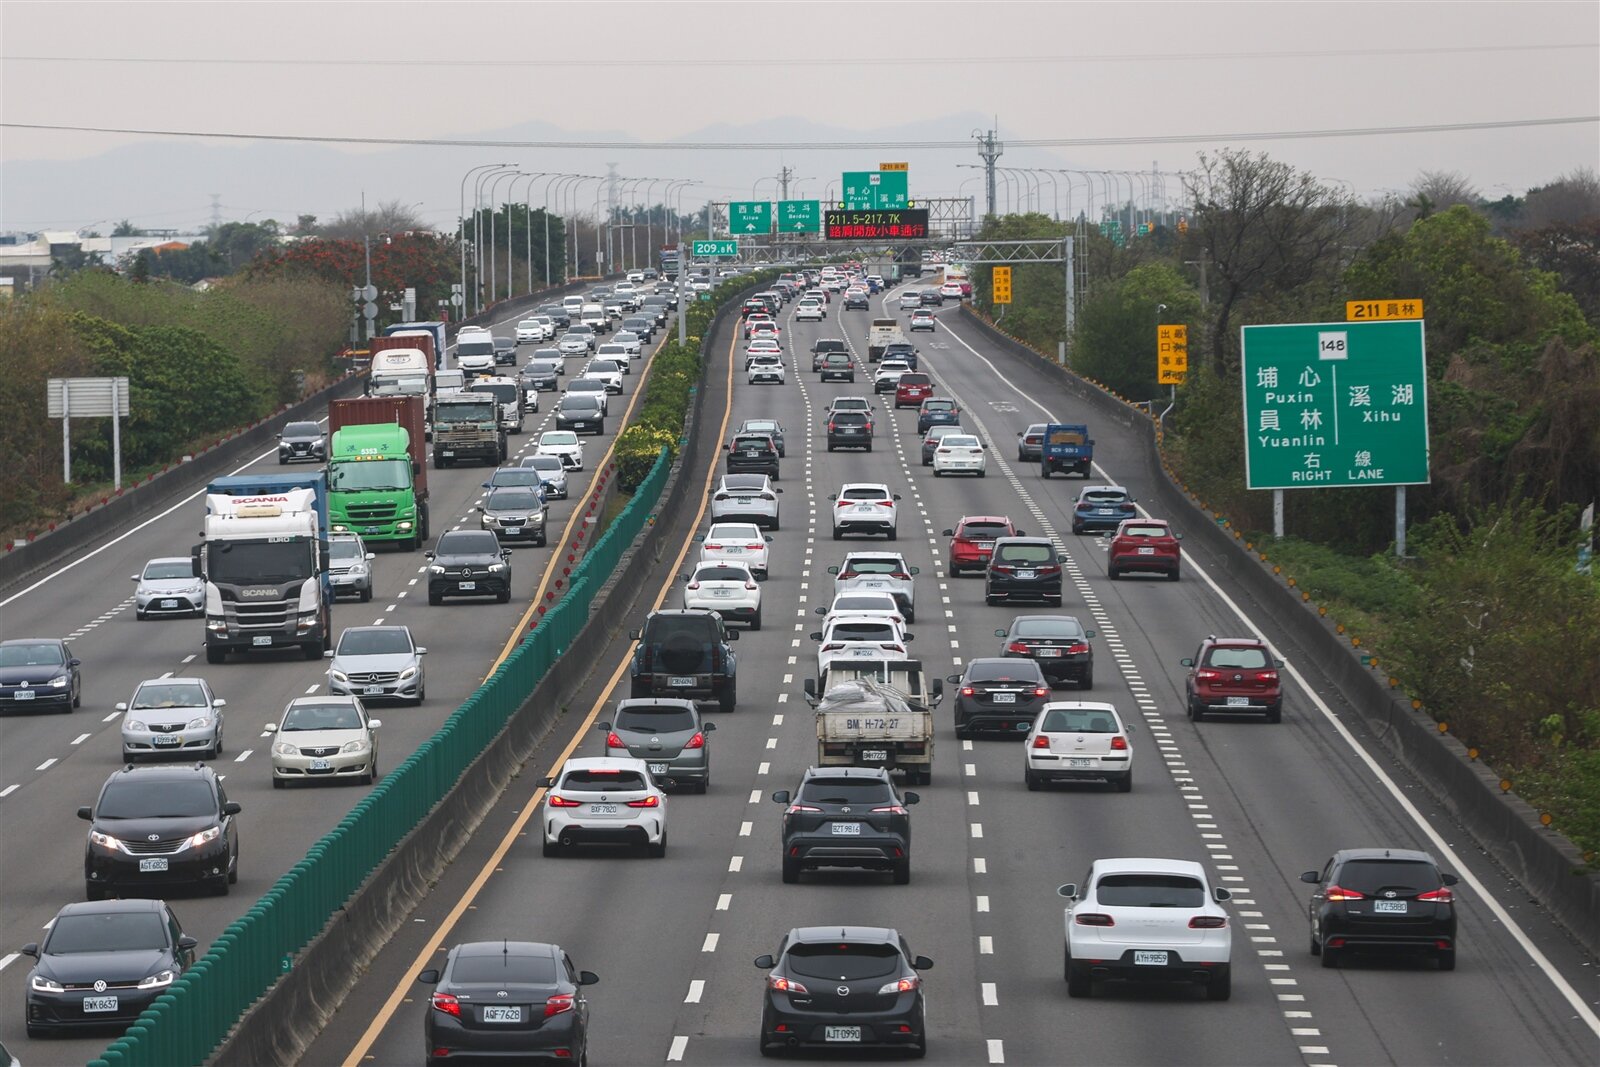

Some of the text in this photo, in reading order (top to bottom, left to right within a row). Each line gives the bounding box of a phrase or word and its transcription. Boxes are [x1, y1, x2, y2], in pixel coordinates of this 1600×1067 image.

[1354, 303, 1416, 318] 211 員林
[1320, 340, 1346, 352] 148
[1256, 366, 1321, 388] 埔心
[1265, 391, 1314, 404] Puxin
[1349, 384, 1414, 407] 溪湖
[1259, 408, 1323, 432] 員林
[1362, 410, 1401, 423] Xihu
[1258, 434, 1325, 448] Yuanlin
[1292, 468, 1384, 481] RIGHT LANE
[232, 496, 289, 505] SCANIA
[242, 588, 279, 597] SCANIA
[847, 719, 860, 729] BM
[282, 960, 289, 969] 3
